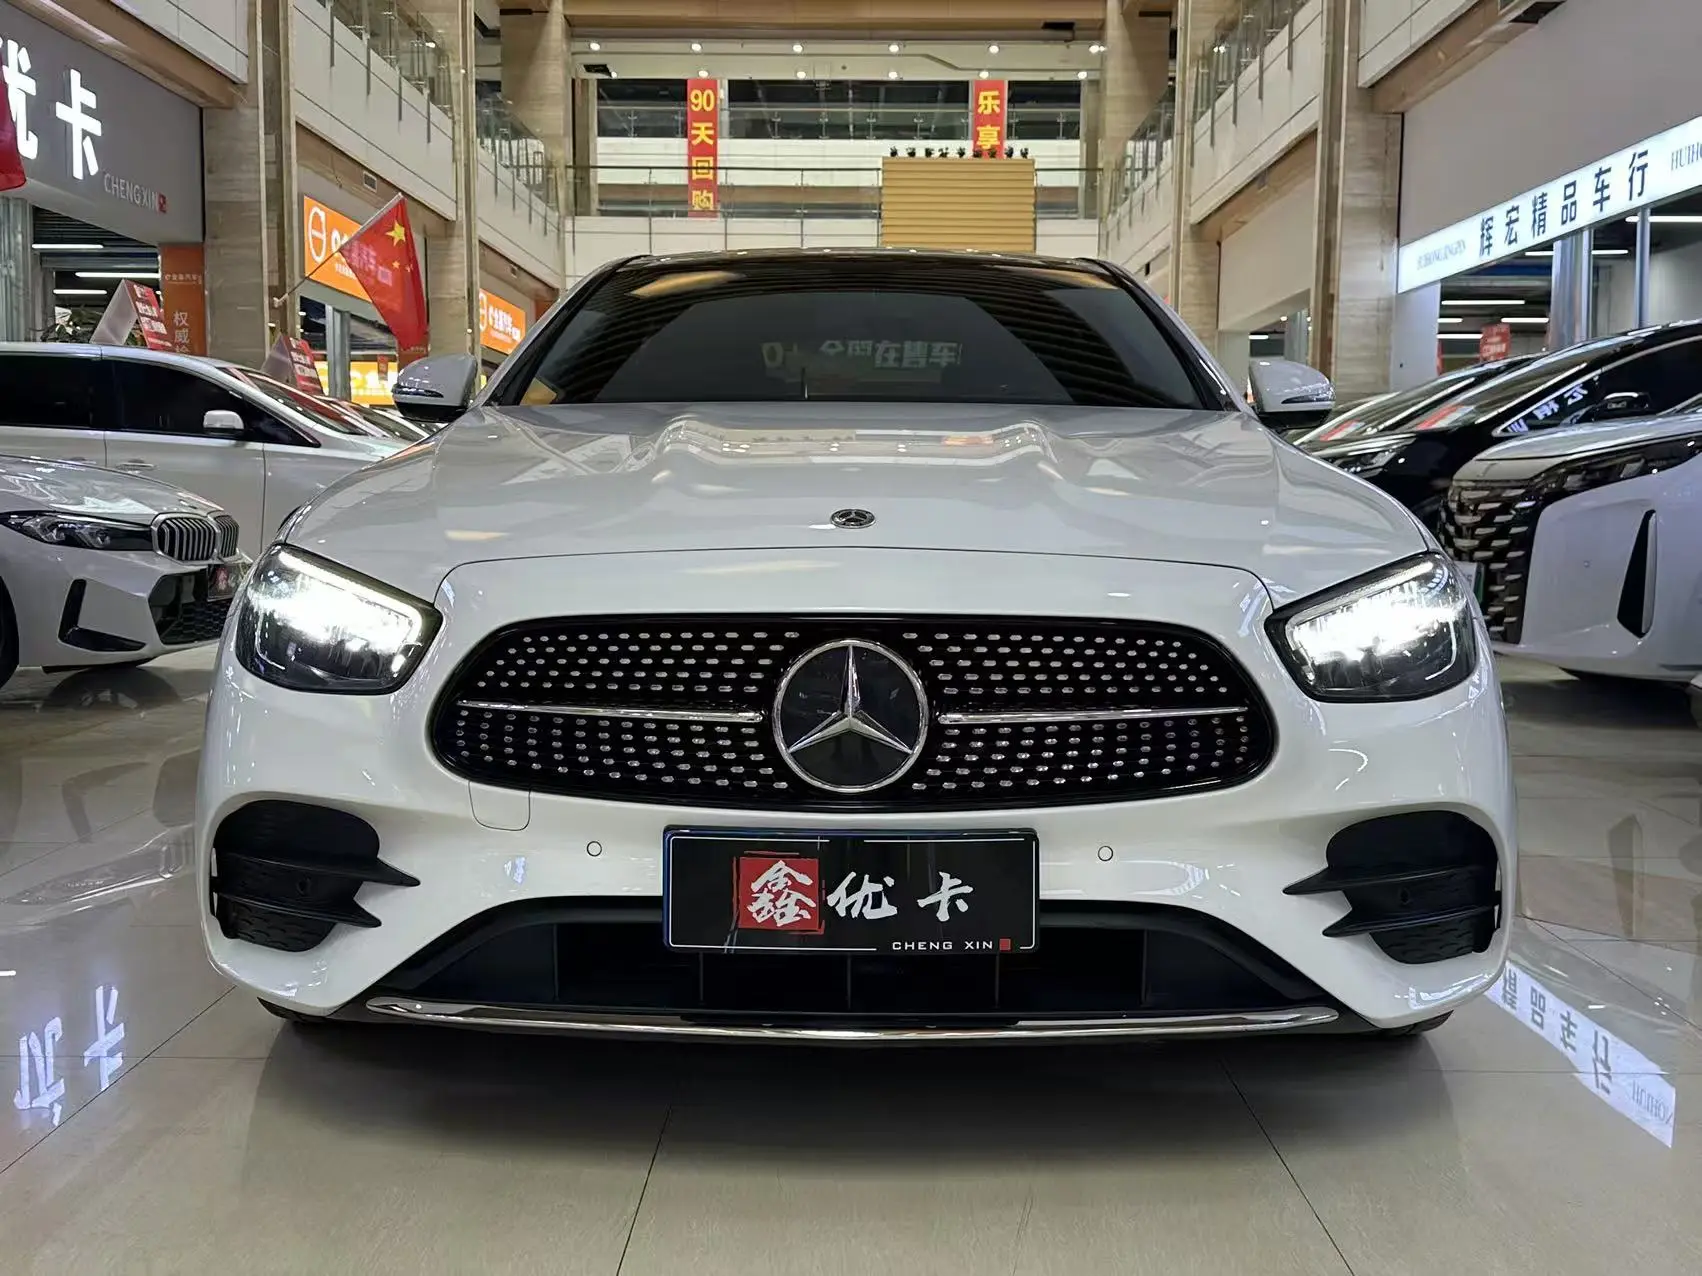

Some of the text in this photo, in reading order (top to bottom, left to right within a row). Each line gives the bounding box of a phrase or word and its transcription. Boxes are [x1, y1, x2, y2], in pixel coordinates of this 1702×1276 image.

[690, 89, 715, 210] 90天回购
[977, 90, 1001, 150] 乐享
[1479, 149, 1649, 257] 辉宏精品车行
[892, 940, 993, 950] CHENG XIN
